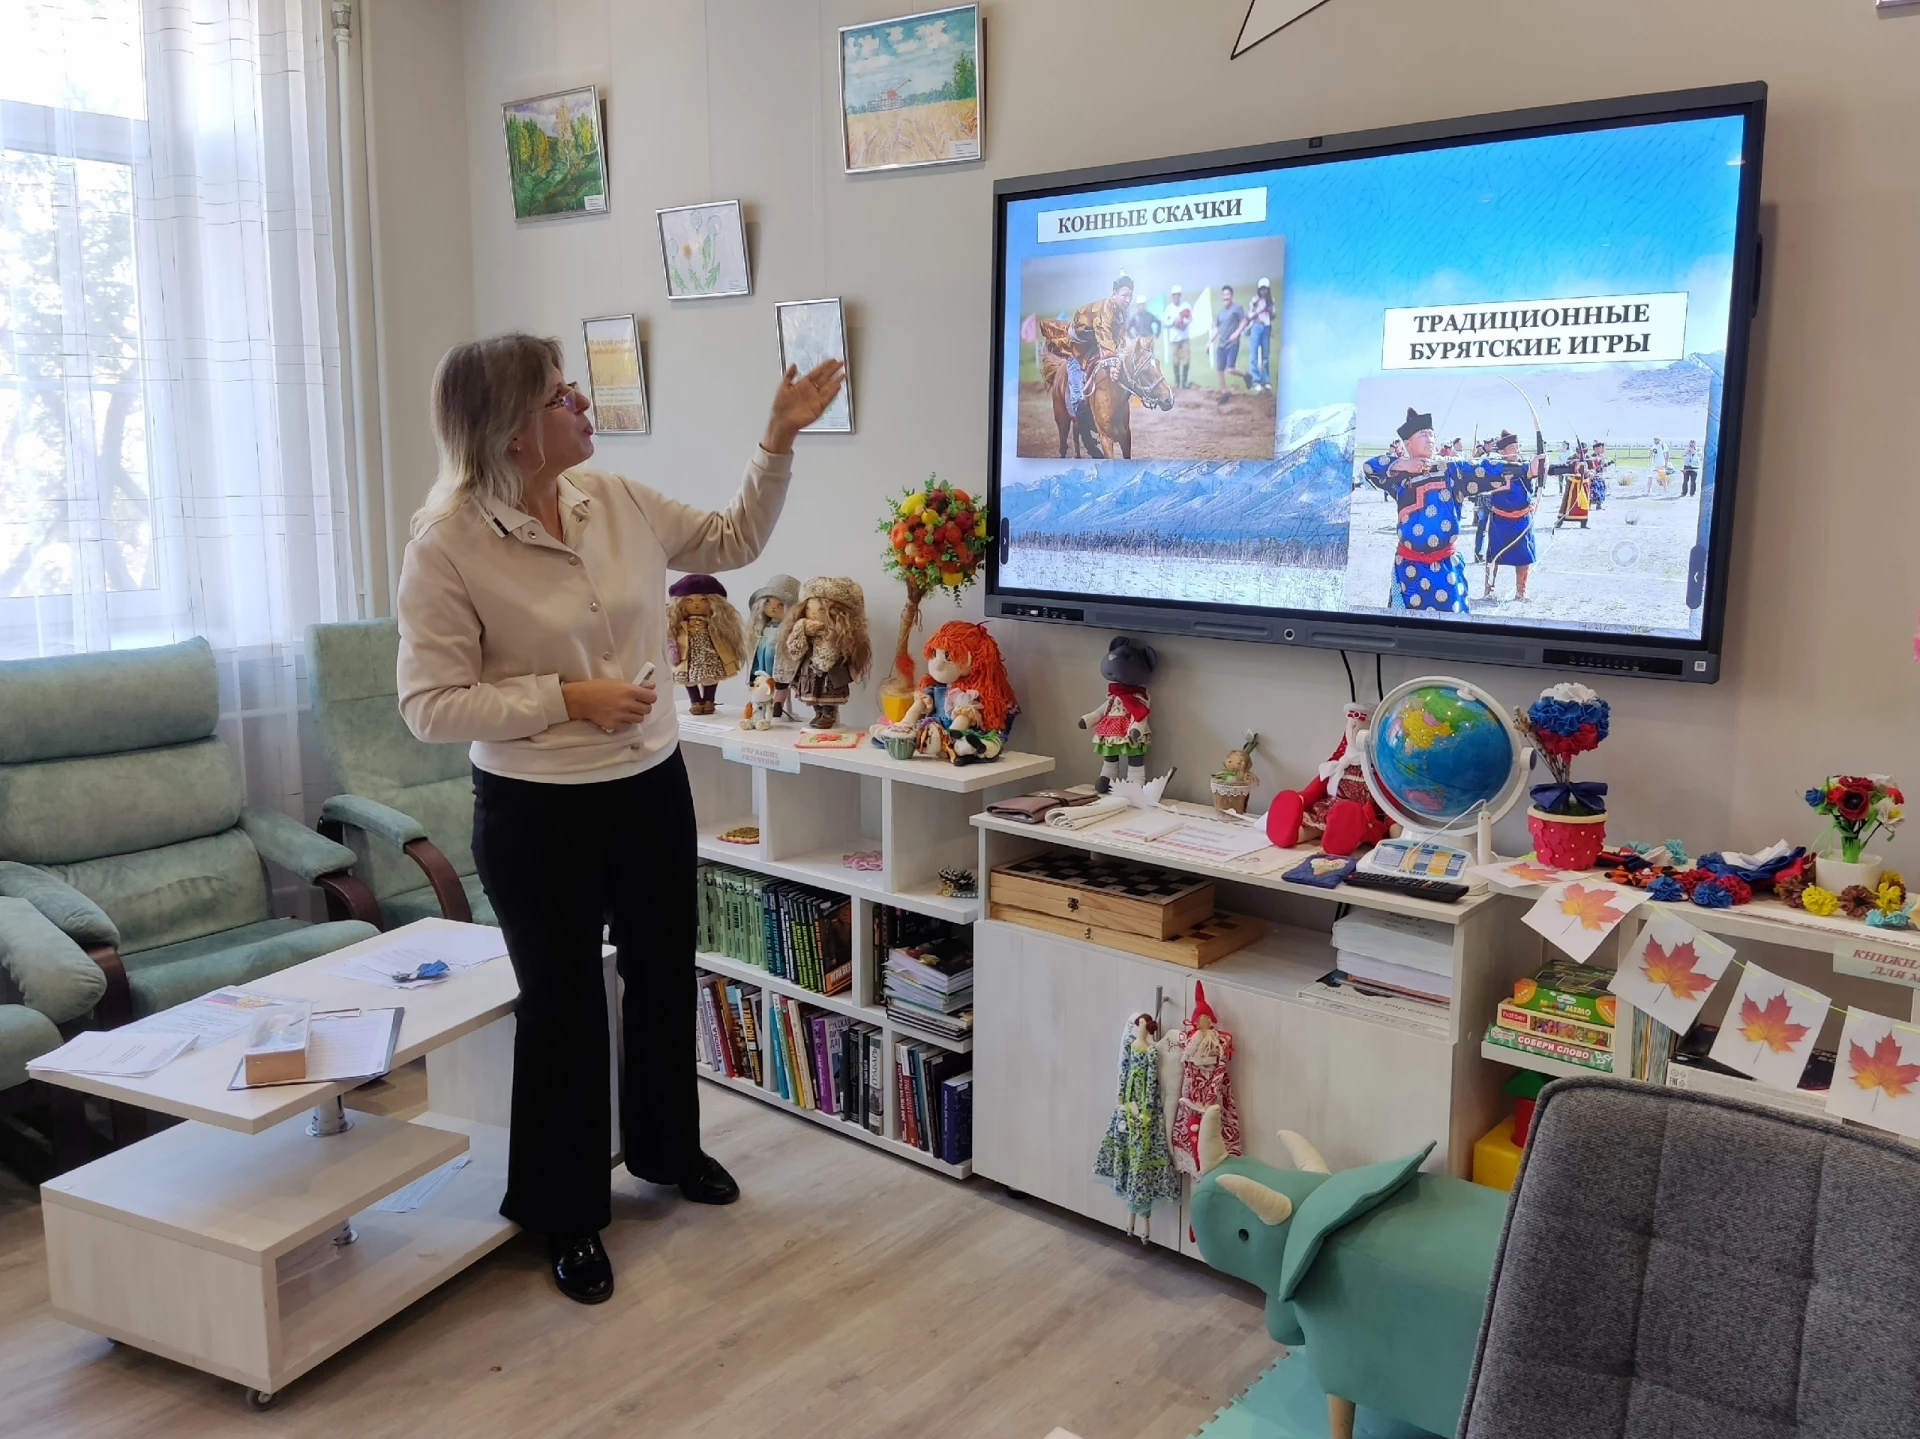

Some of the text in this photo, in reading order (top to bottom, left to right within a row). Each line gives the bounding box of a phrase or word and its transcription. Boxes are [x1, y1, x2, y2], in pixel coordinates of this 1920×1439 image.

[1057, 198, 1243, 234] КОННЫЕ СКАЧКИ
[1413, 303, 1650, 334] ТРАДИЦИОННЫЕ
[1409, 333, 1651, 361] БУРЯТСКИЕ ИГРЫ
[1852, 949, 1920, 970] КНИЖН
[1871, 965, 1907, 980] ДЛЯ
[743, 1009, 756, 1041] ТАЙСОН
[1518, 1035, 1590, 1060] СОБЕРИ СЛОВО
